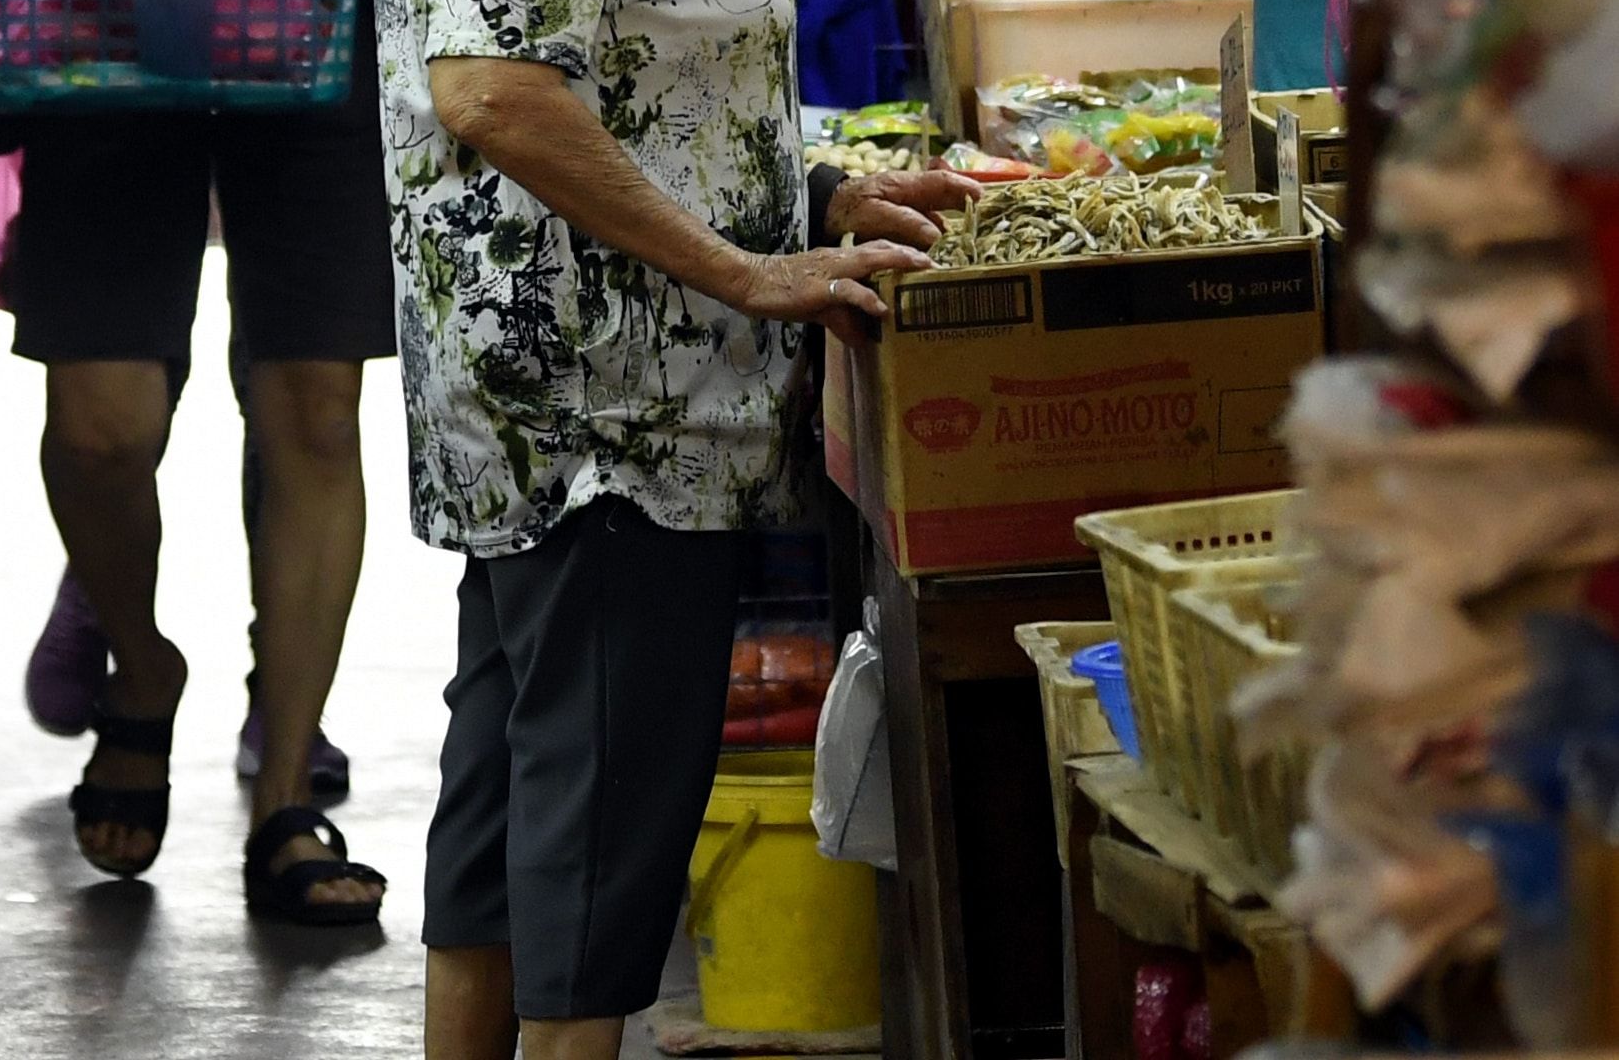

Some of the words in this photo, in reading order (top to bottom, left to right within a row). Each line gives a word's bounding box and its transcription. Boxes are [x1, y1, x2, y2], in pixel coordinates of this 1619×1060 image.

[1185, 279, 1234, 306] 1kg
[1250, 281, 1268, 295] 20
[1272, 278, 1303, 294] PKT
